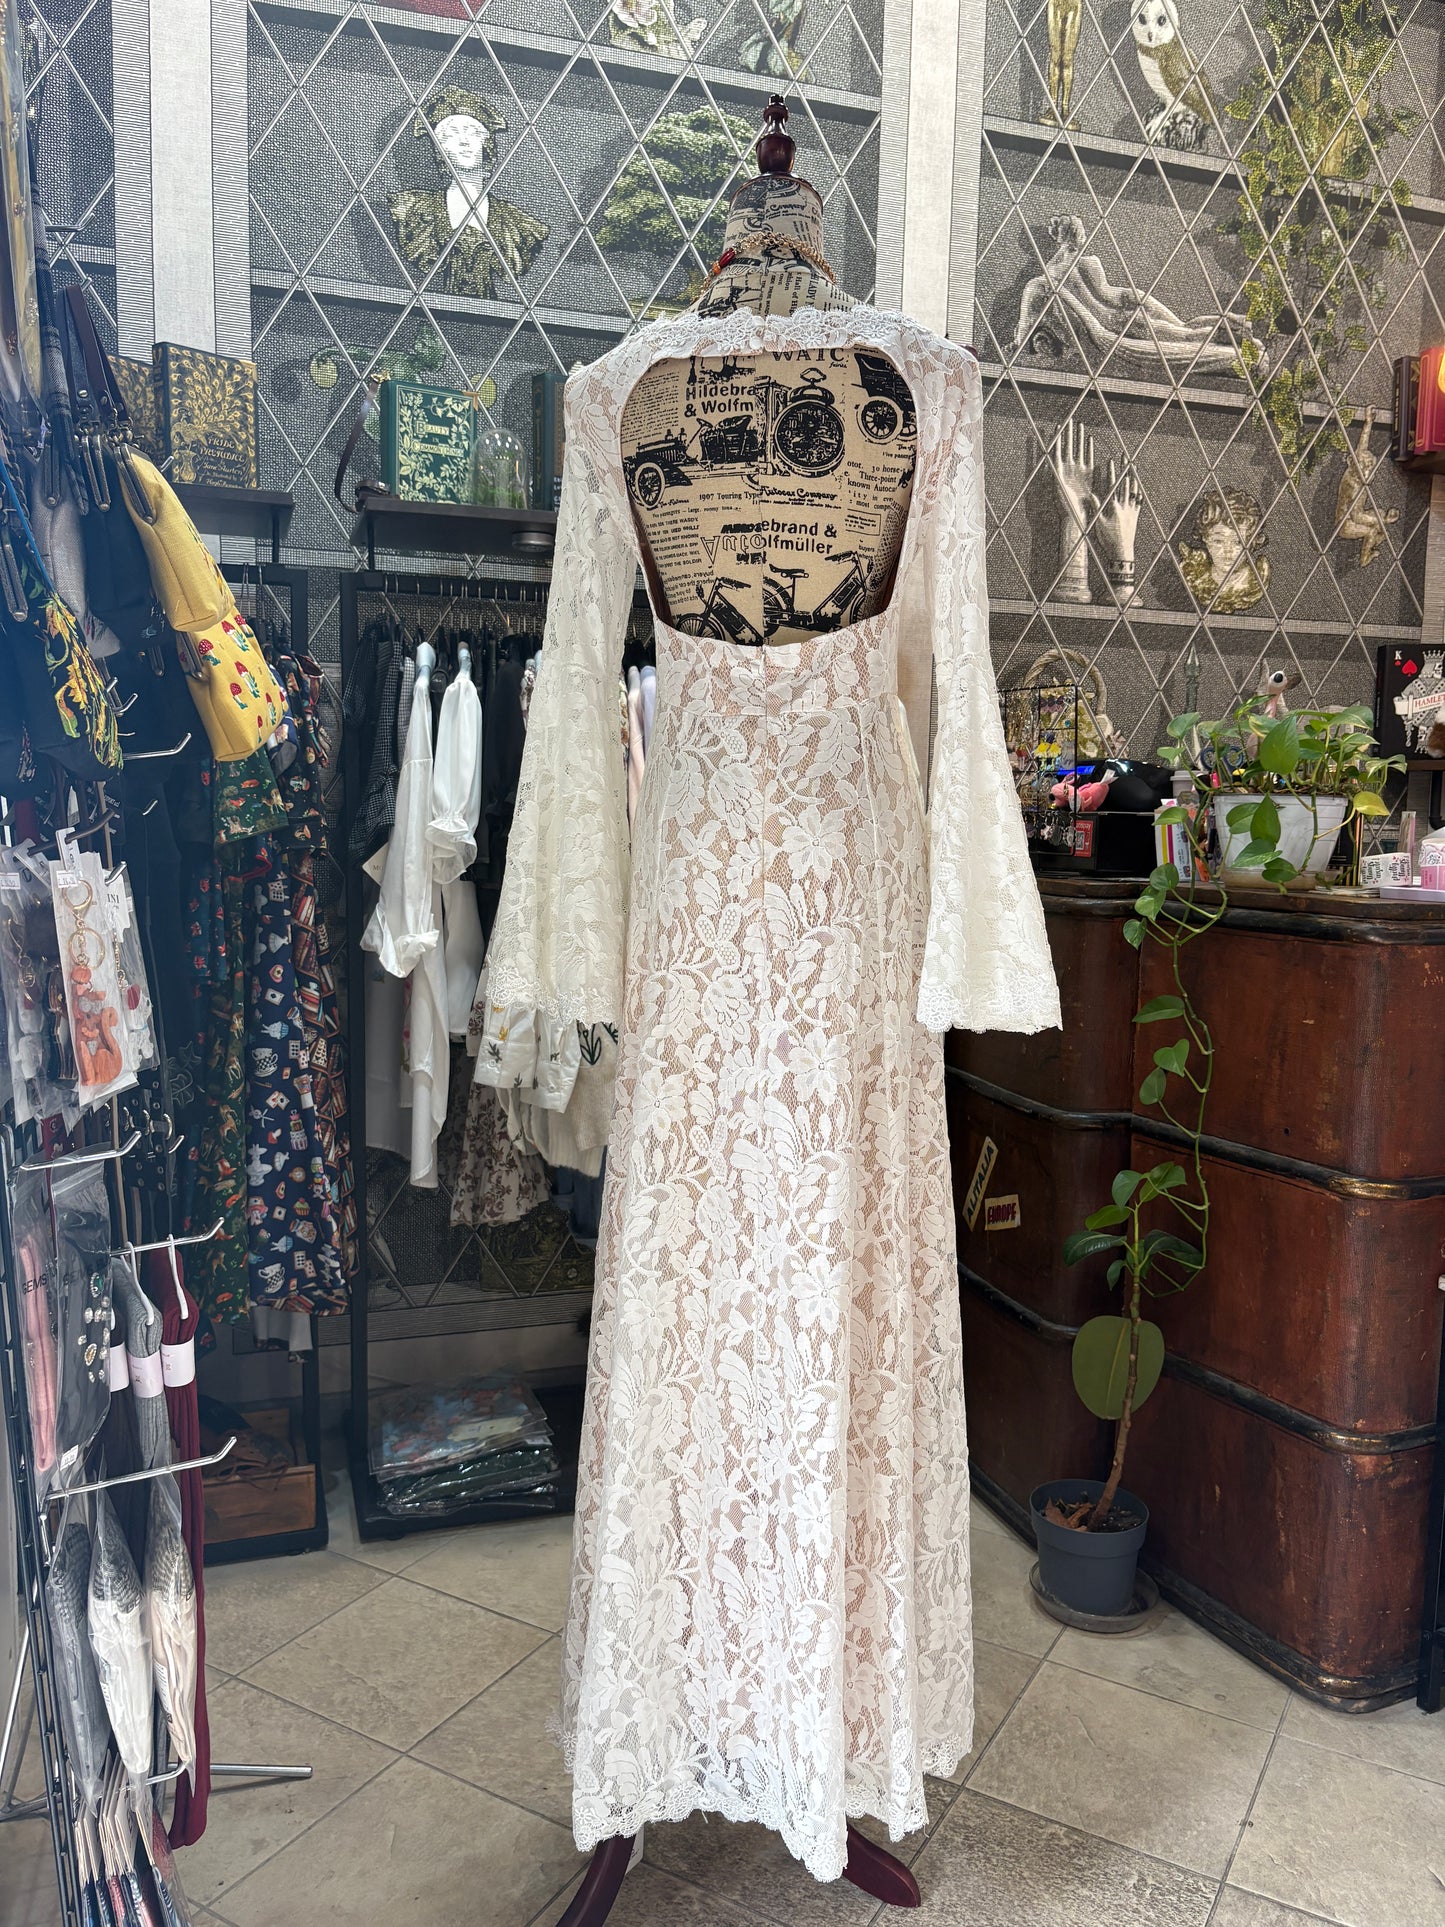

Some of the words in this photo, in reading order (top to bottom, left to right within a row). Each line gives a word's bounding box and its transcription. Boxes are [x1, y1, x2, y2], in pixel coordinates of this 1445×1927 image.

[686, 384, 757, 401] Hildebra
[685, 403, 697, 418] &
[701, 398, 754, 414] Wolfm
[417, 421, 449, 436] BEAUTY
[207, 435, 235, 449] PRIDE
[200, 446, 245, 463] PREJUDICE
[847, 478, 871, 490] known
[859, 471, 897, 485] Three-point
[699, 493, 715, 502] 1907
[717, 492, 743, 501] Touring
[760, 485, 796, 497] Autocar
[796, 488, 838, 501] Company
[761, 518, 819, 537] ebrand
[823, 523, 838, 539] &
[1394, 650, 1402, 660] K
[967, 1145, 994, 1224] ALITALIA
[987, 1203, 1017, 1225] EUROPE
[22, 1273, 48, 1295] GEMS
